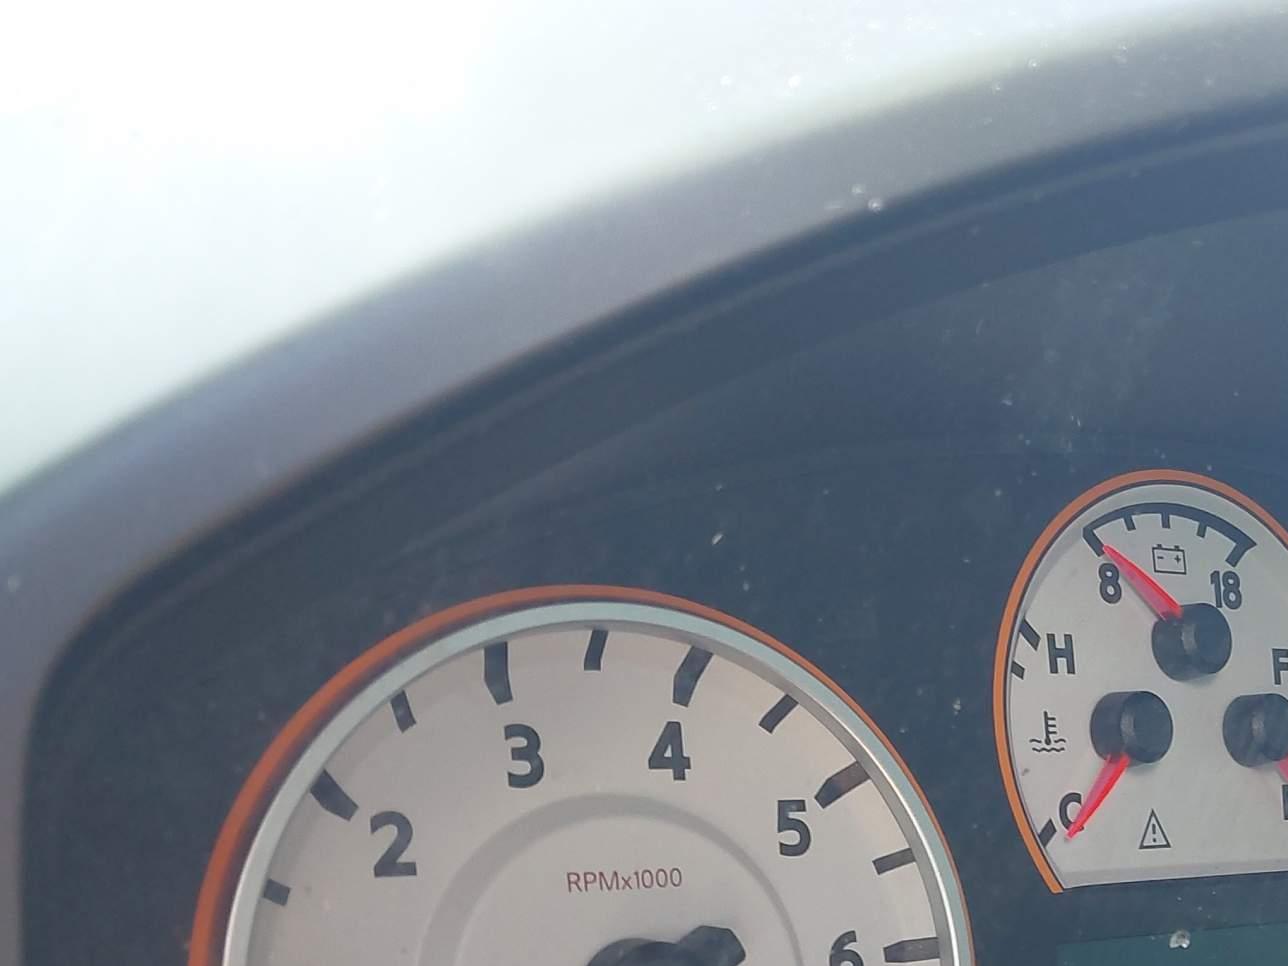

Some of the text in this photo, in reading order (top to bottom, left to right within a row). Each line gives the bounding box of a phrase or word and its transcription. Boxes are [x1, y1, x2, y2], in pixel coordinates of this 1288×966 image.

[1099, 563, 1122, 603] 8
[1211, 571, 1242, 609] 18
[1047, 633, 1075, 674] H
[503, 724, 545, 788] 3
[648, 721, 691, 781] 4
[776, 799, 812, 857] 5
[1059, 792, 1084, 832] C
[370, 811, 417, 878] 2
[566, 867, 684, 893] RPMx1000
